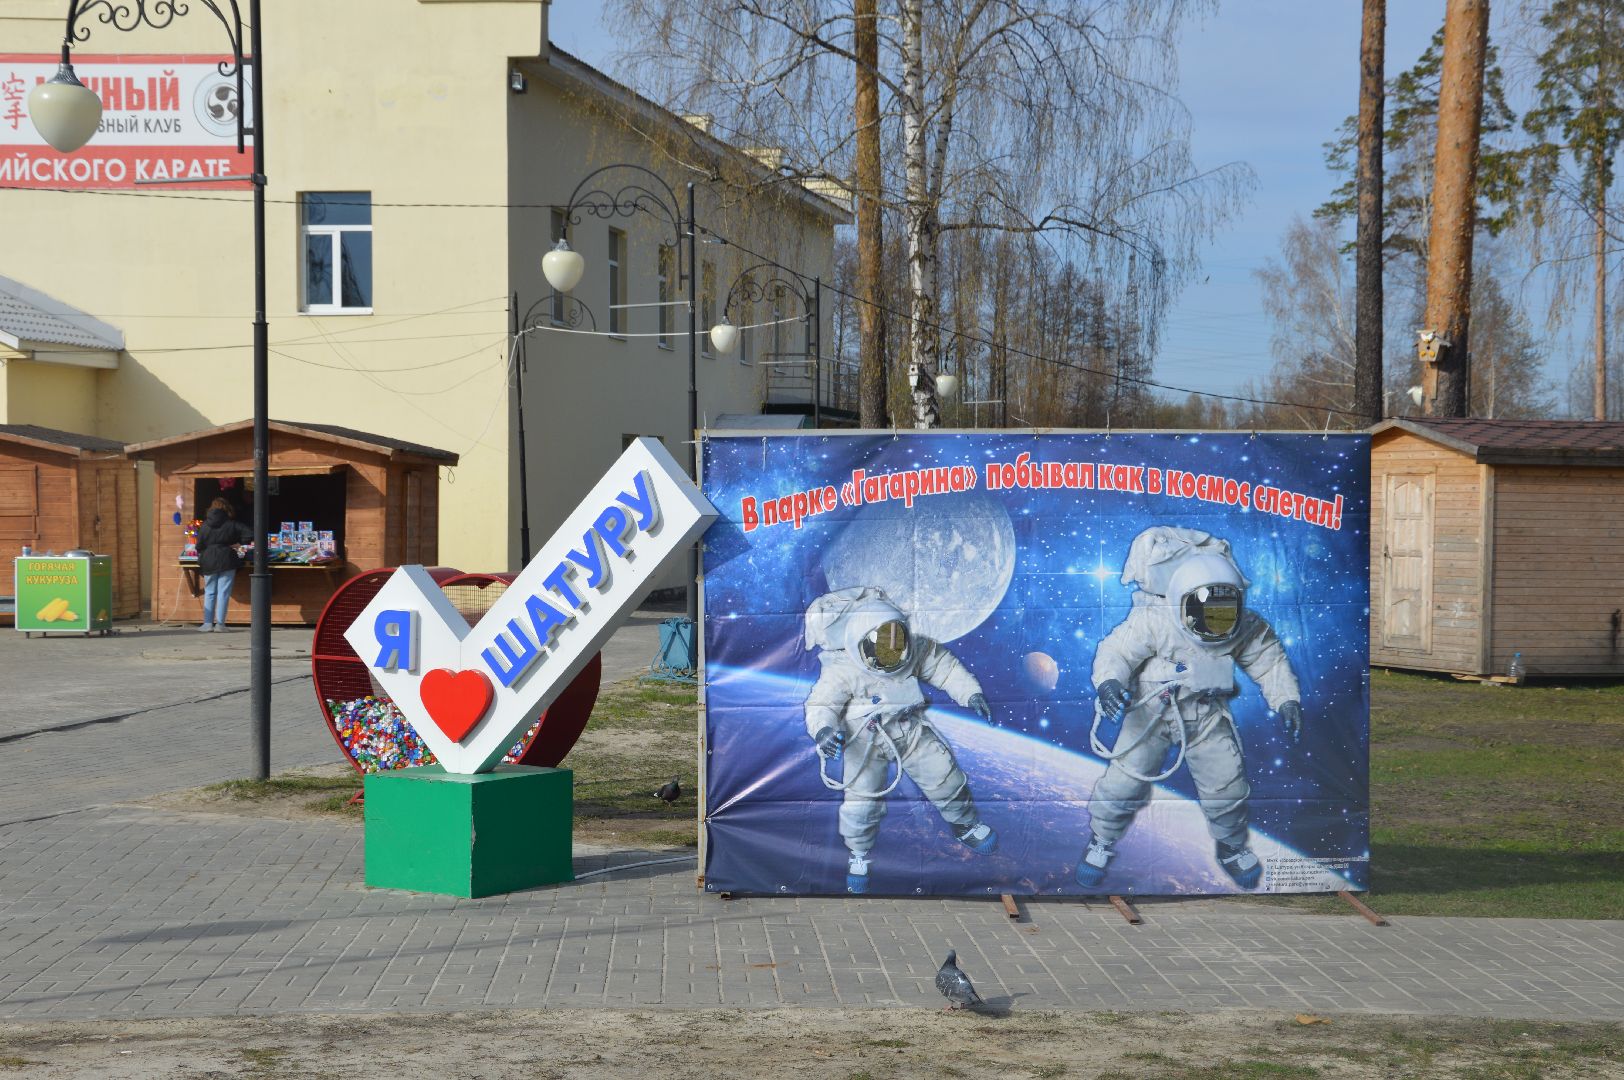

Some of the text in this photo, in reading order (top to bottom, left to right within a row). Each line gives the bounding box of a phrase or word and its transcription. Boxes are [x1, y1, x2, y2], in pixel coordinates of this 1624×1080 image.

[36, 70, 180, 111] НЫЙ
[144, 118, 182, 133] КЛУБ
[135, 158, 231, 180] КАРАТЕ
[742, 496, 759, 532] В
[763, 485, 837, 529] парке
[841, 465, 978, 508] «Гагарина»
[986, 452, 1095, 490] побывал
[1098, 463, 1144, 492] как
[1166, 469, 1251, 507] космос
[1253, 484, 1343, 531] слетал!
[26, 575, 79, 585] КУКУРУЗА
[29, 562, 75, 571] ГОРЯЧАЯ
[480, 469, 664, 689] ШАТУРУ
[373, 609, 421, 672] Я
